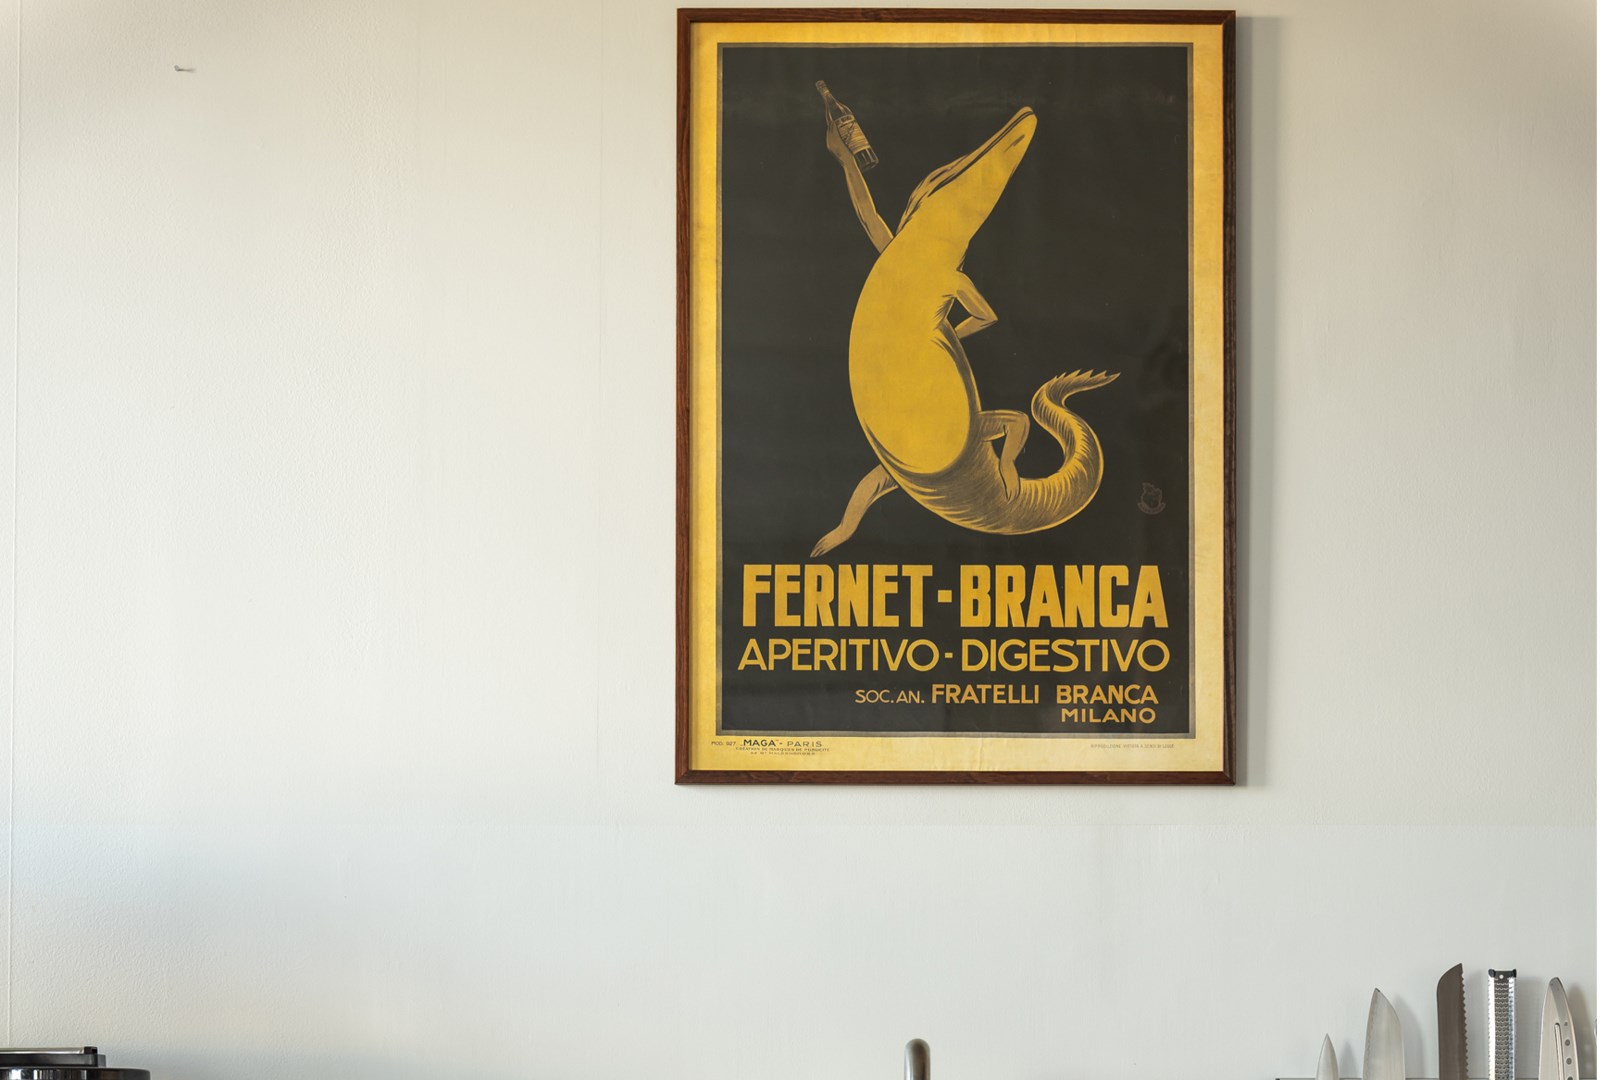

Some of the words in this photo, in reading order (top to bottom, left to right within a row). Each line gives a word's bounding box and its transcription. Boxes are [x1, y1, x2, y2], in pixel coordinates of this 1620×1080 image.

[931, 684, 1039, 704] FRATELLI
[1056, 684, 1159, 705] BRANCA
[1061, 708, 1156, 724] MILANO
